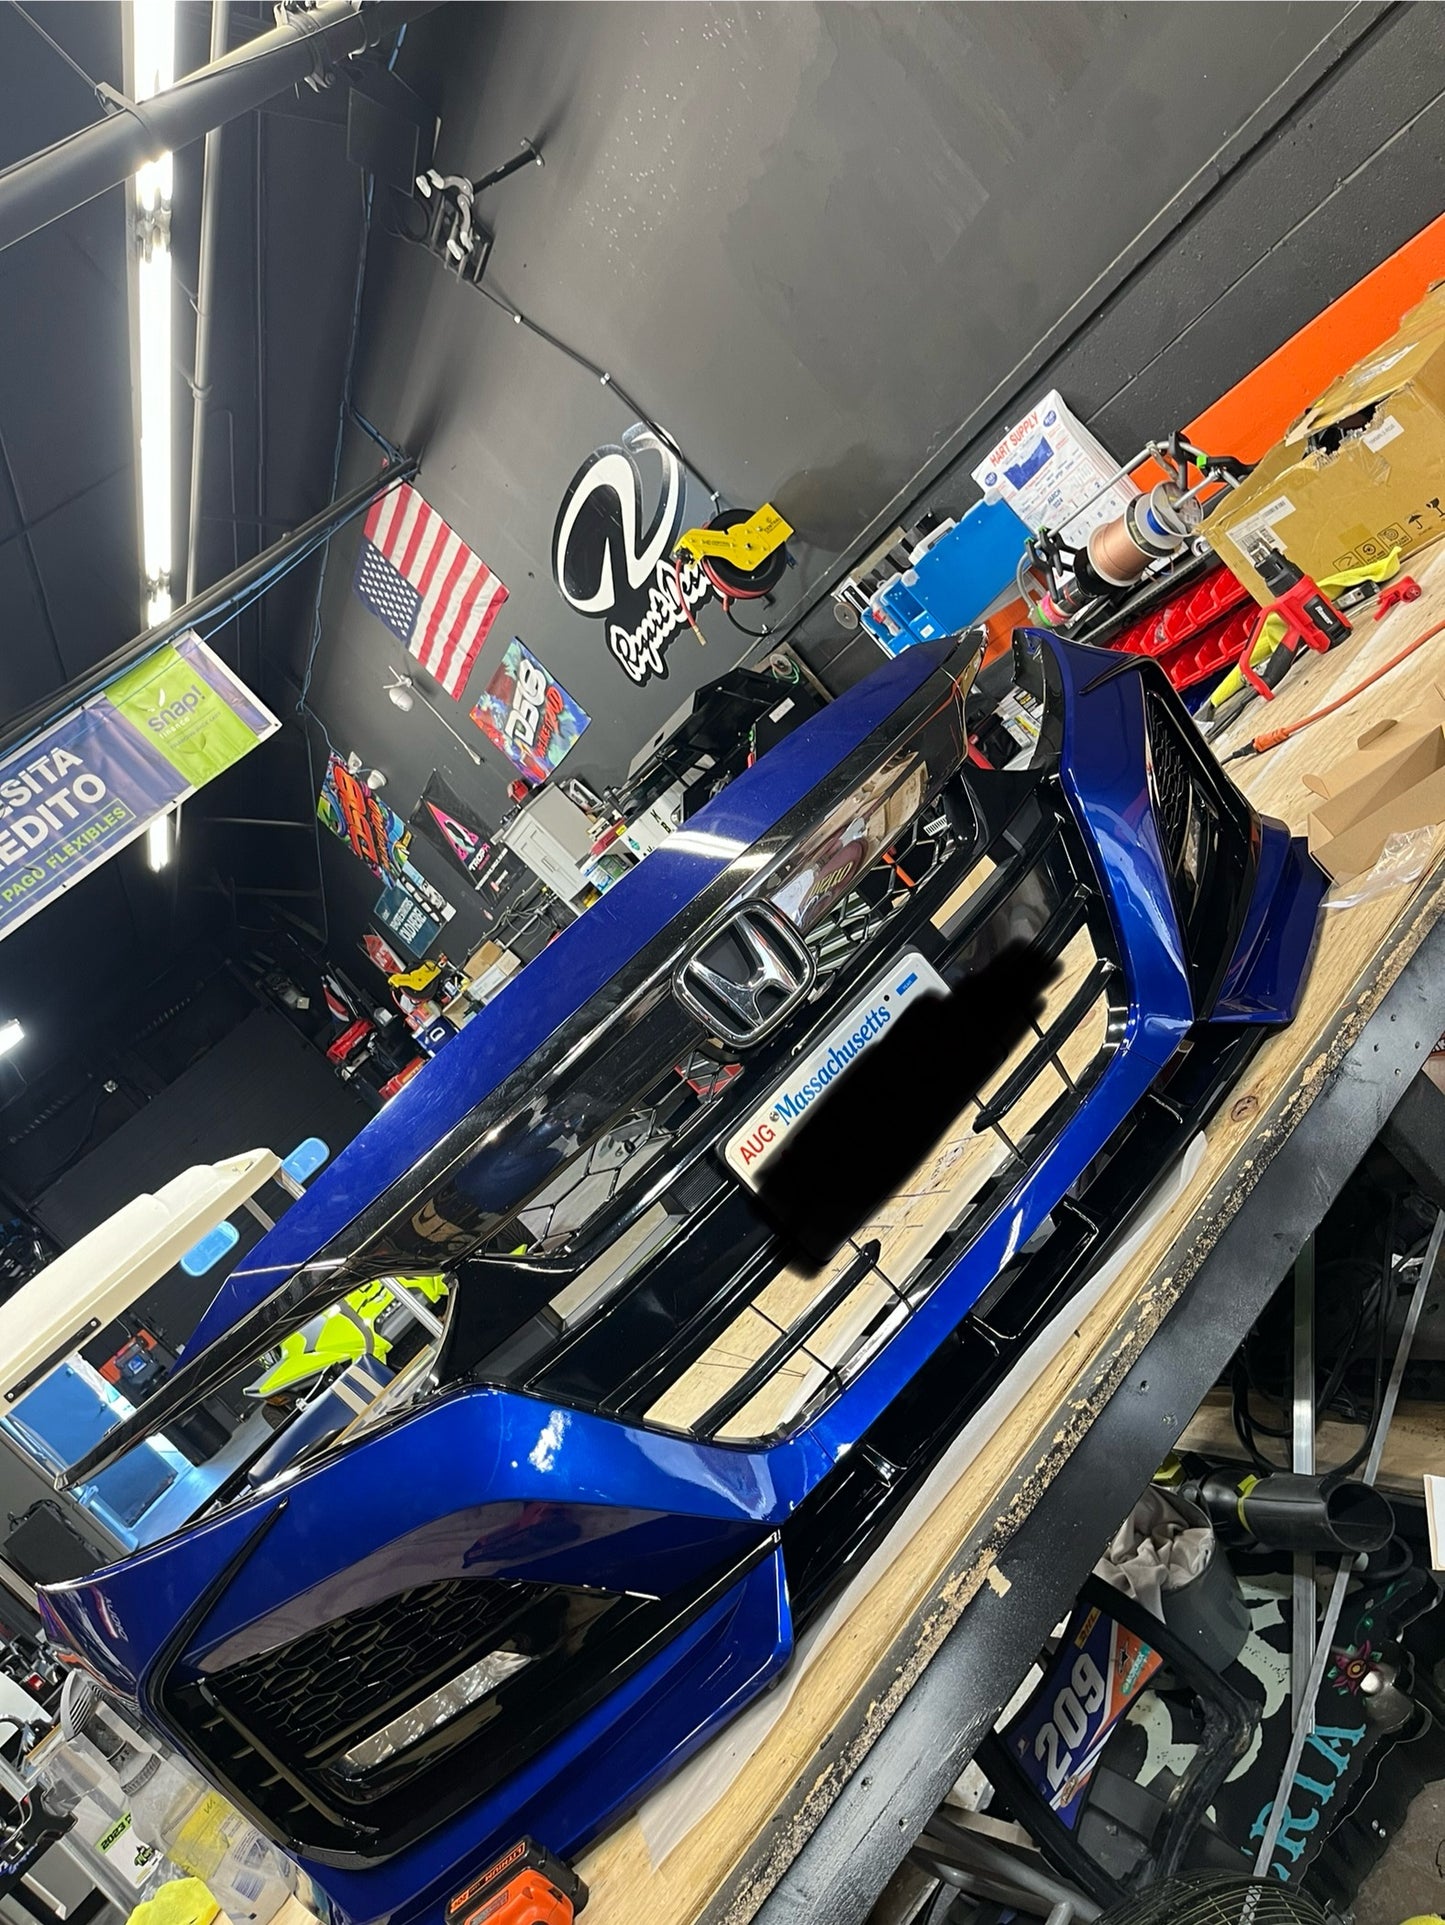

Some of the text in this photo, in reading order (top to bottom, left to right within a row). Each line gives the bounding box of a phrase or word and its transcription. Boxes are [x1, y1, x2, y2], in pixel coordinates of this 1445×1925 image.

[989, 440, 1011, 467] HART
[1009, 411, 1038, 446] SUPPLY
[148, 685, 206, 733] snap!
[0, 773, 106, 869] EDITO
[2, 806, 126, 904] PAGO FLEXIBLES
[739, 1004, 892, 1166] AUG Massachusetts
[1035, 1652, 1106, 1790] 209
[100, 1821, 126, 1849] 2023
[484, 1847, 522, 1881] LITHIUM
